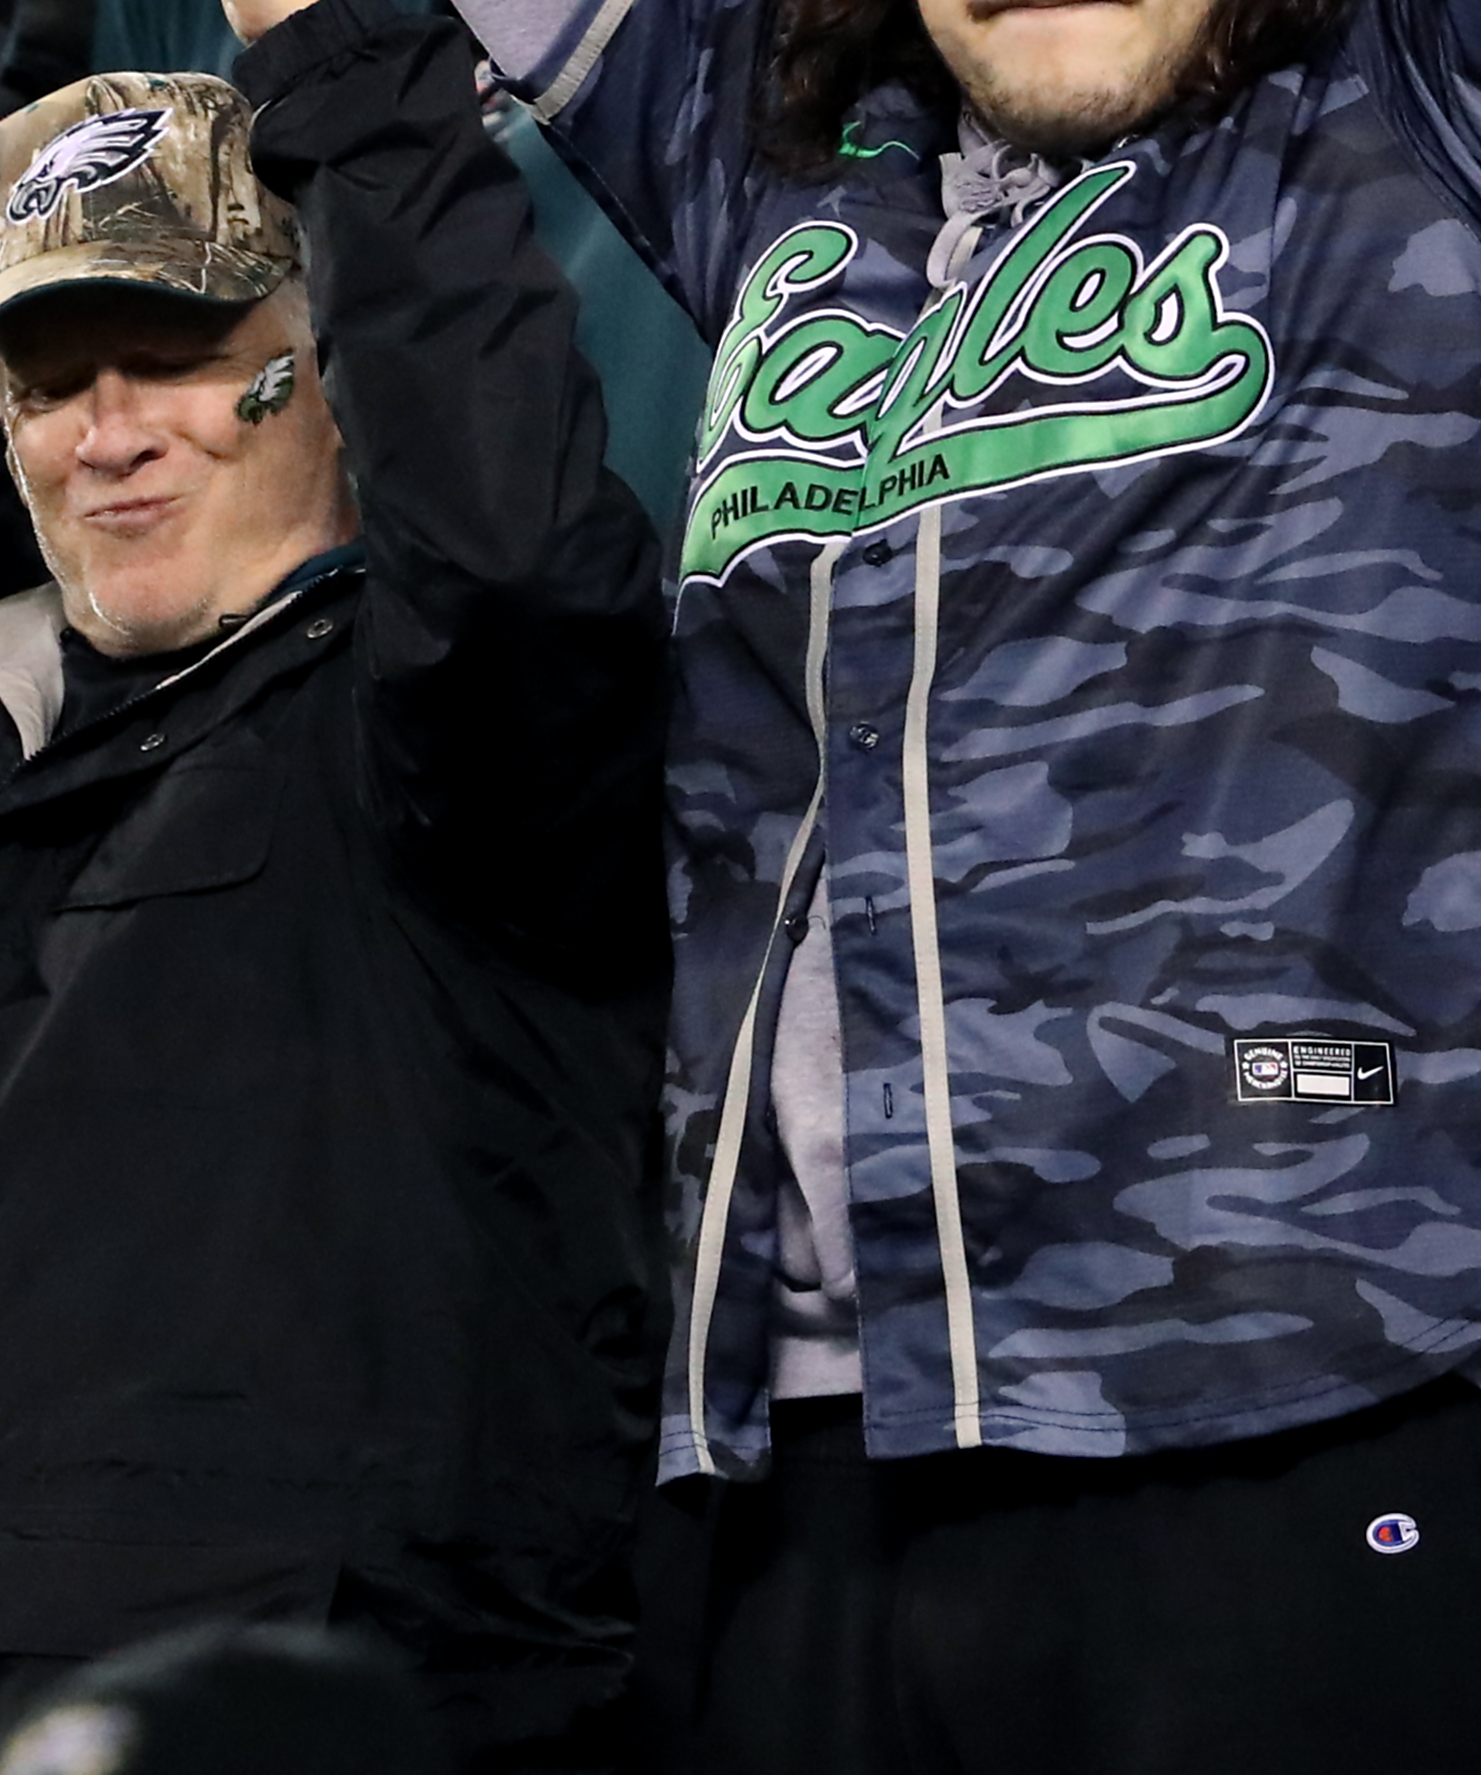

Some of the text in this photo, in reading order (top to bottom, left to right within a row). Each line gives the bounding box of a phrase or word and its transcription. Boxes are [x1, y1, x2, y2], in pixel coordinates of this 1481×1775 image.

[696, 161, 1274, 475] Eagles
[709, 454, 950, 540] PHILADELPHIA
[1292, 1045, 1352, 1057] ENGINEERED
